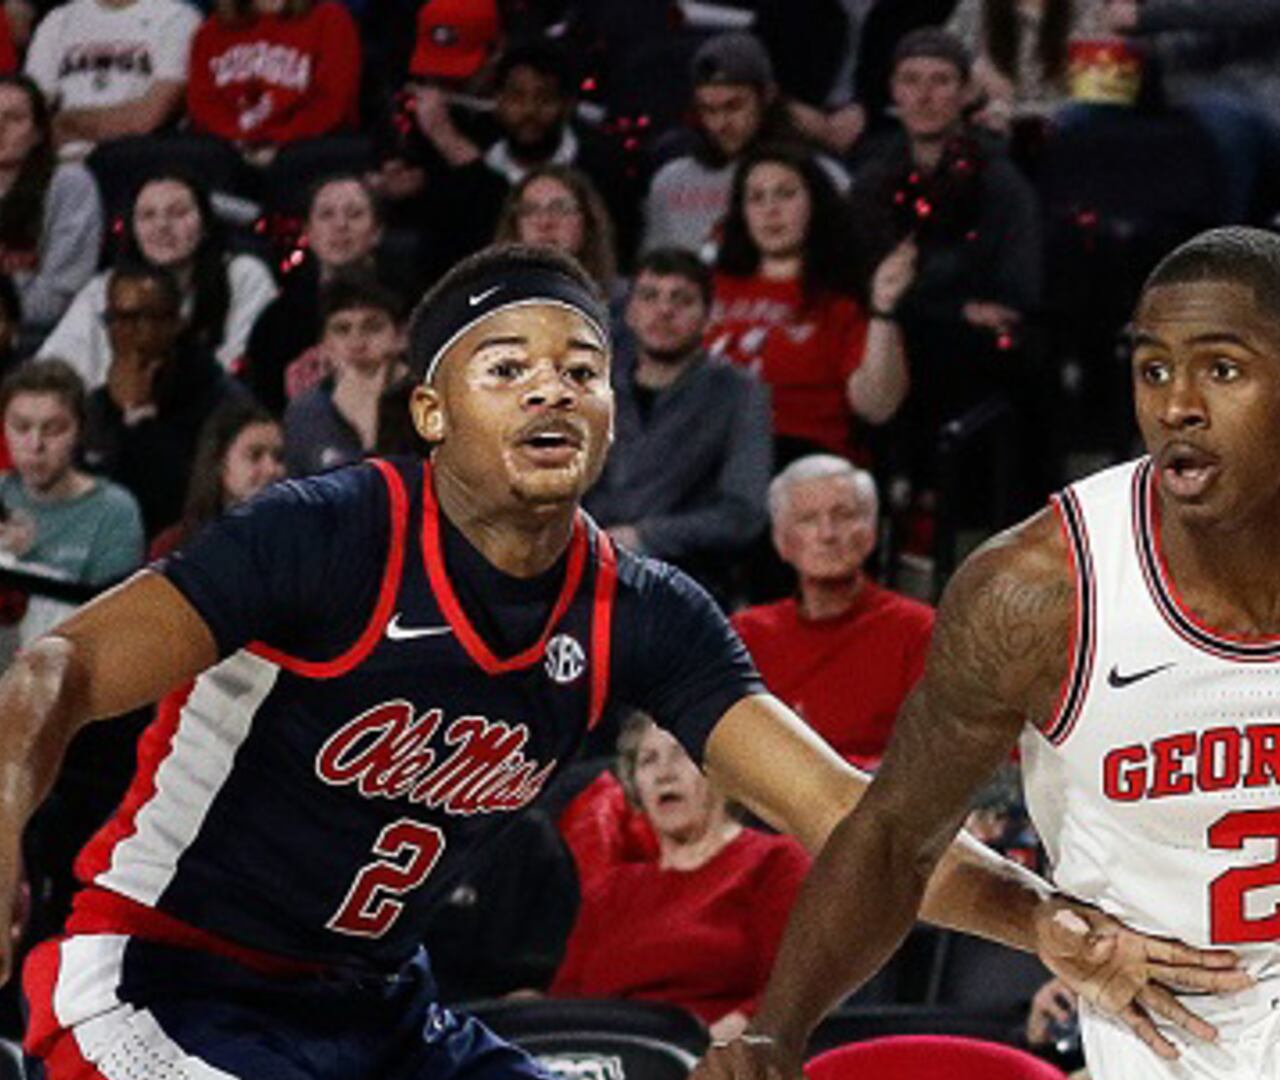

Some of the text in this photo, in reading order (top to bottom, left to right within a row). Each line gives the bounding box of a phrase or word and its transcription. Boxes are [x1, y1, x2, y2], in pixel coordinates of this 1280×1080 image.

[544, 633, 587, 683] SEC
[315, 698, 557, 817] Ole Miss
[324, 816, 447, 939] 2
